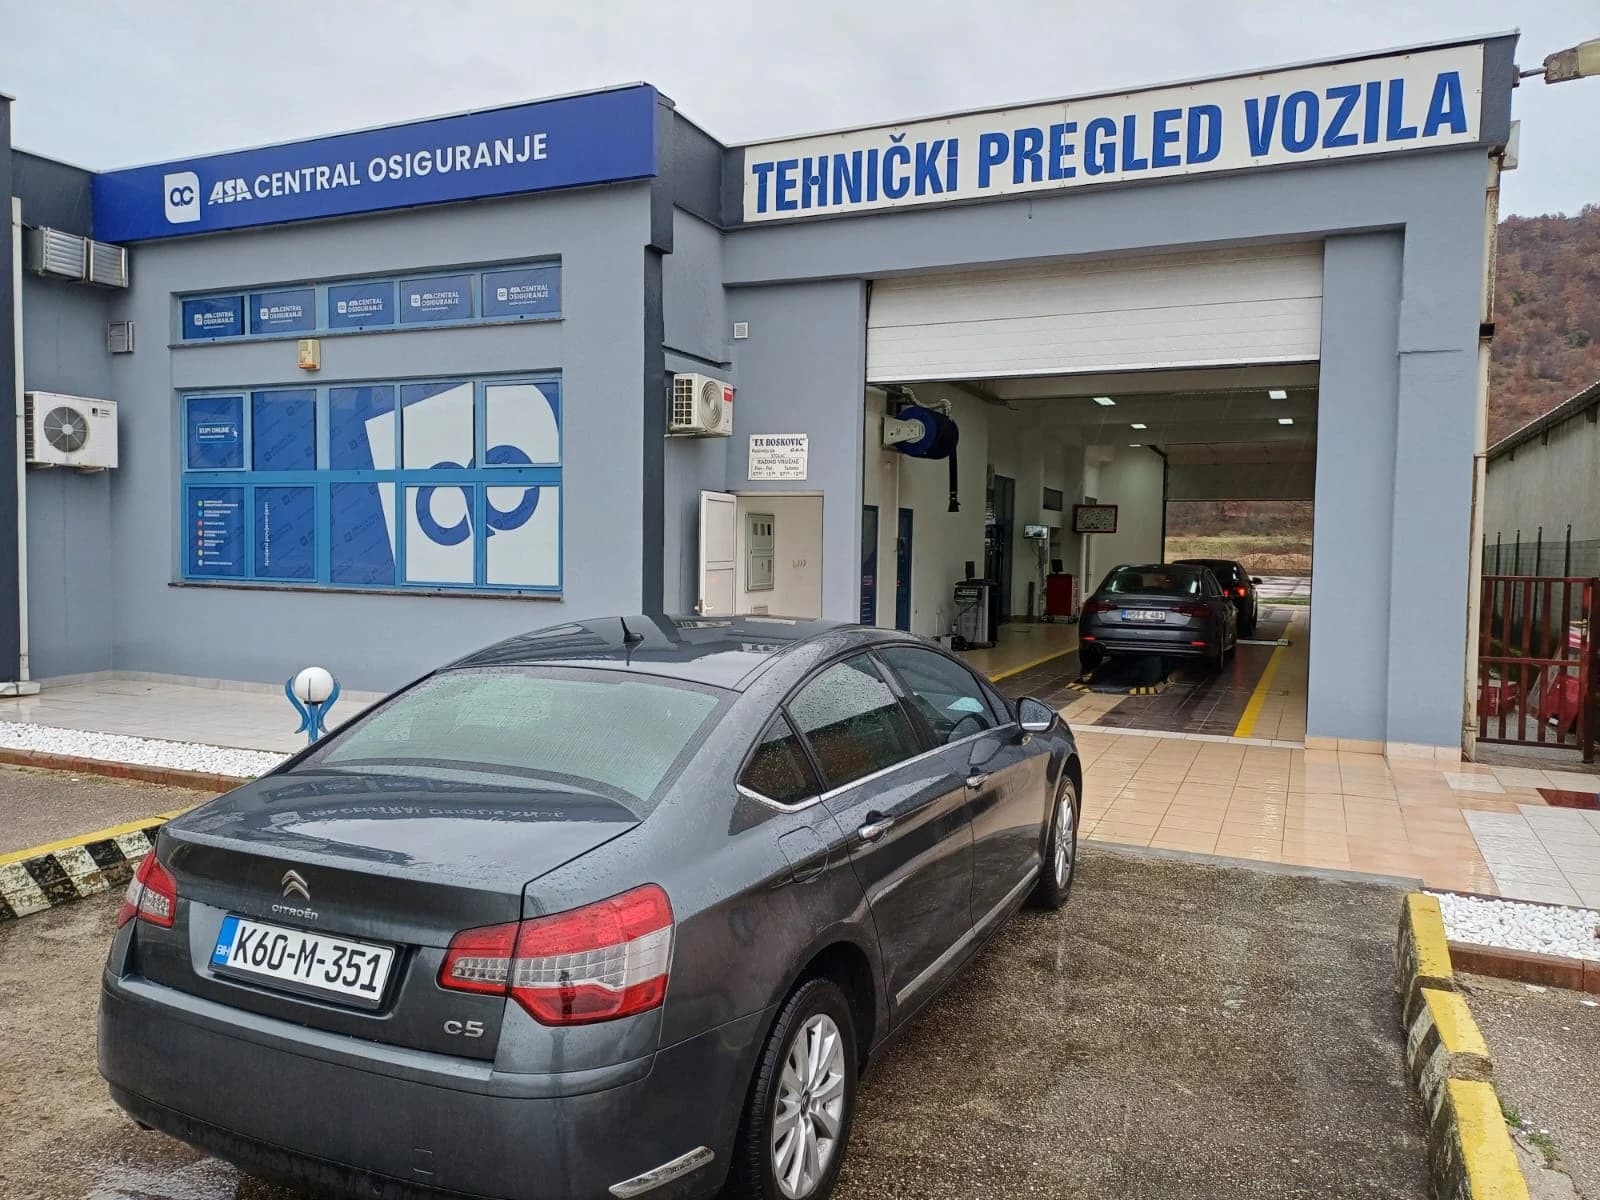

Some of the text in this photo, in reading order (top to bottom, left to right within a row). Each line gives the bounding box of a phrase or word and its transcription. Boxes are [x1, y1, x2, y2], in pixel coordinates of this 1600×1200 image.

[752, 71, 1468, 214] TEHNIČKI PREGLED VOZILA
[207, 133, 547, 205] ASA CENTRAL OSIGURANJE
[433, 291, 459, 299] CENTRAL
[521, 284, 549, 292] CENTRAL
[233, 926, 382, 993] K60-M-351
[443, 1020, 484, 1038] C5
